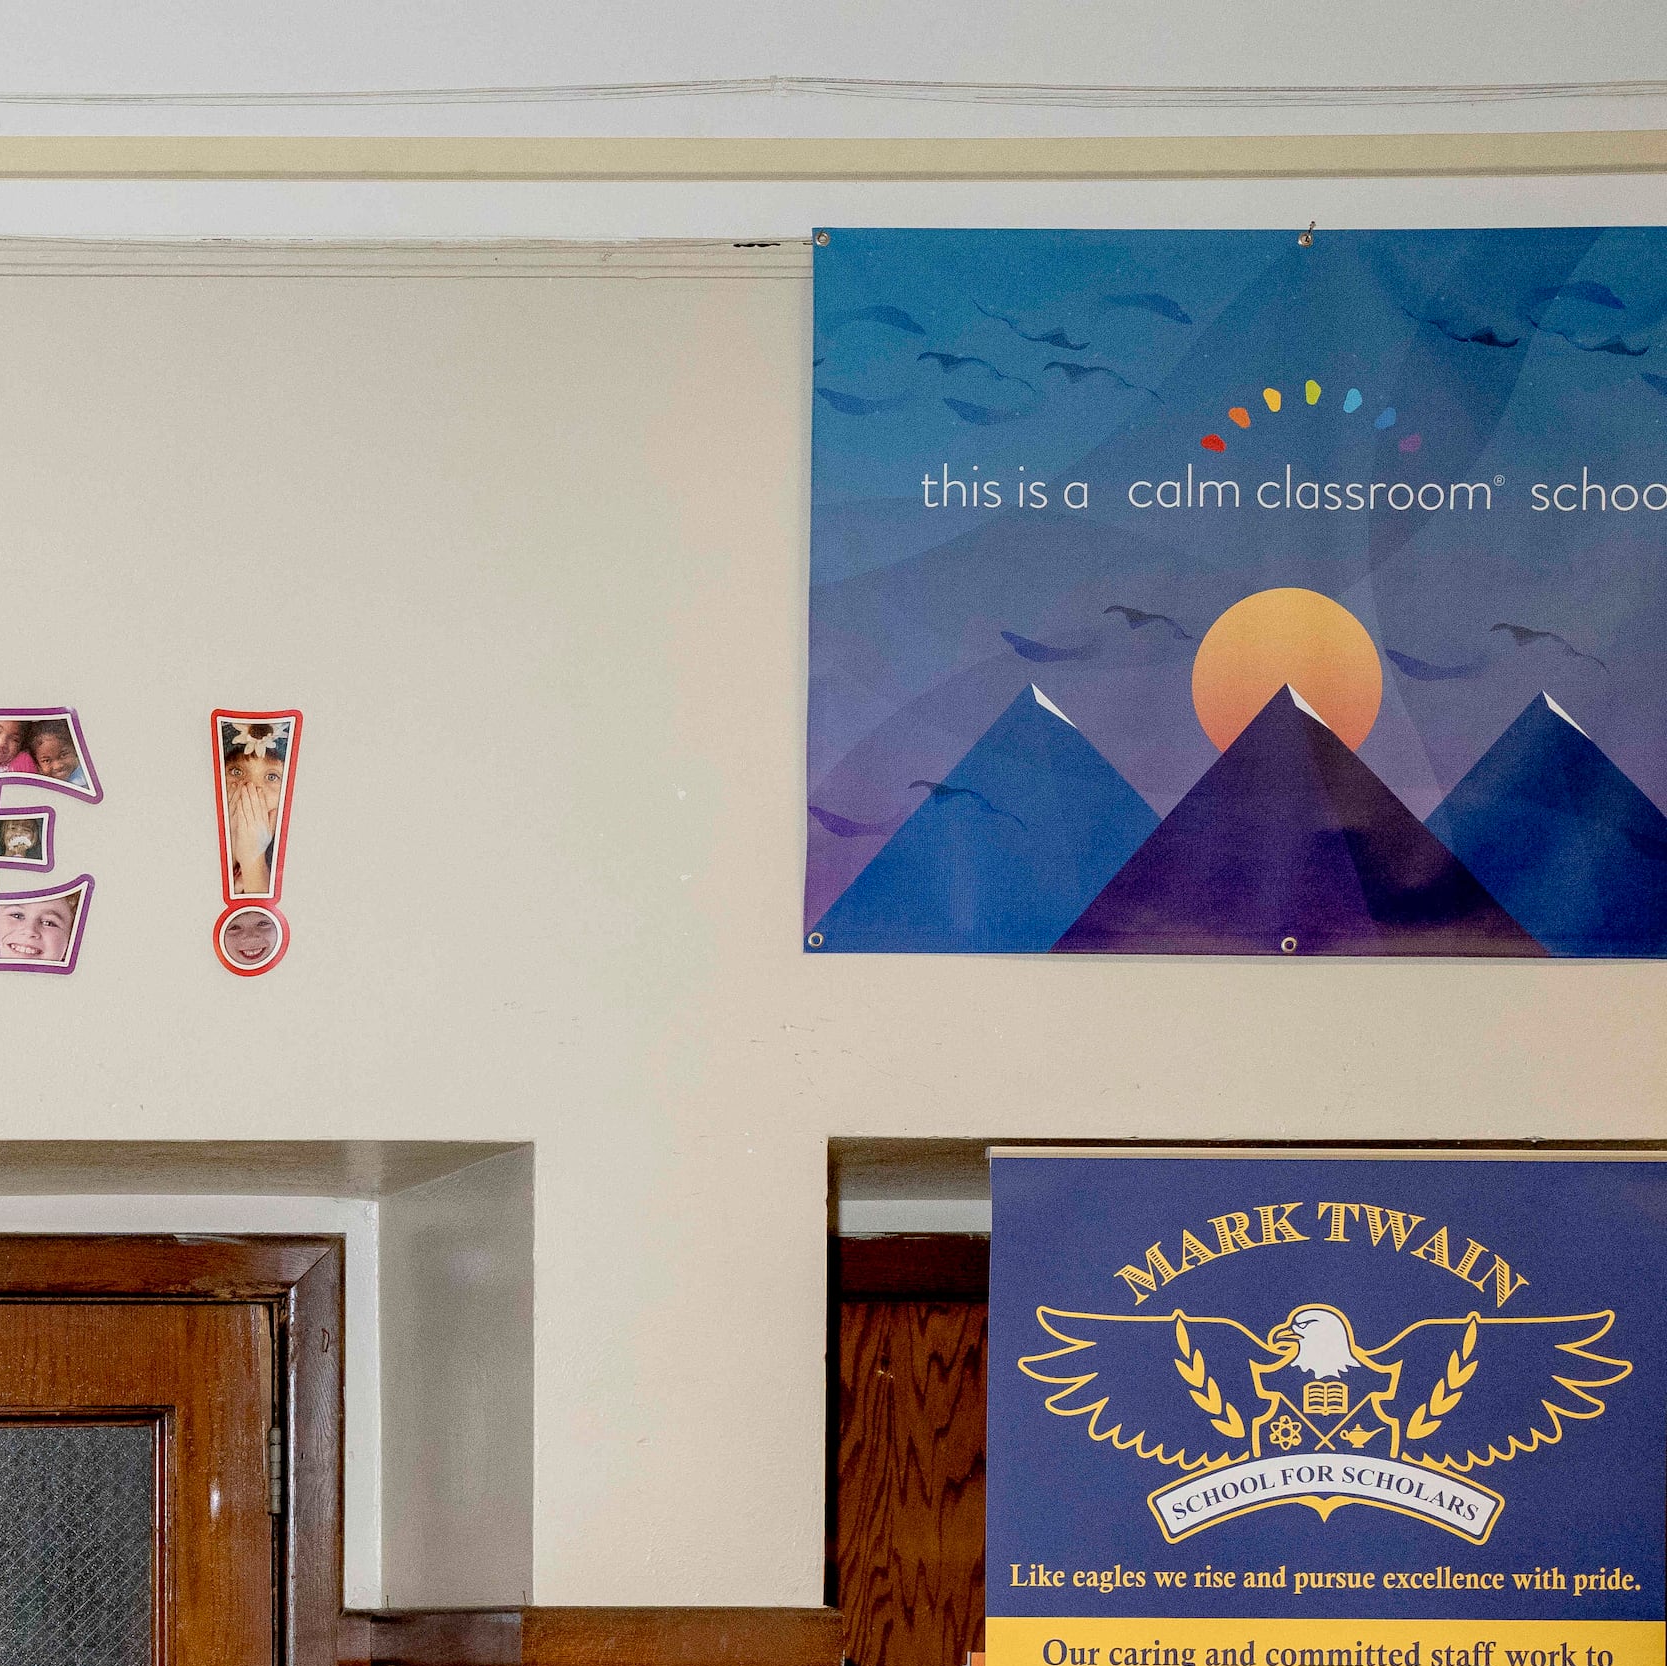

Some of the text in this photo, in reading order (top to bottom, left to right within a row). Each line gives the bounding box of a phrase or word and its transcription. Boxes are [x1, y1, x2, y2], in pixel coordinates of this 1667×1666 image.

[921, 463, 1001, 508] this
[1019, 466, 1047, 508] is
[1064, 482, 1088, 509] a
[1129, 464, 1239, 508] calm
[1114, 1202, 1529, 1307] MARK TWAIN
[1171, 1466, 1480, 1522] SCHOOL FOR SCHOLARS
